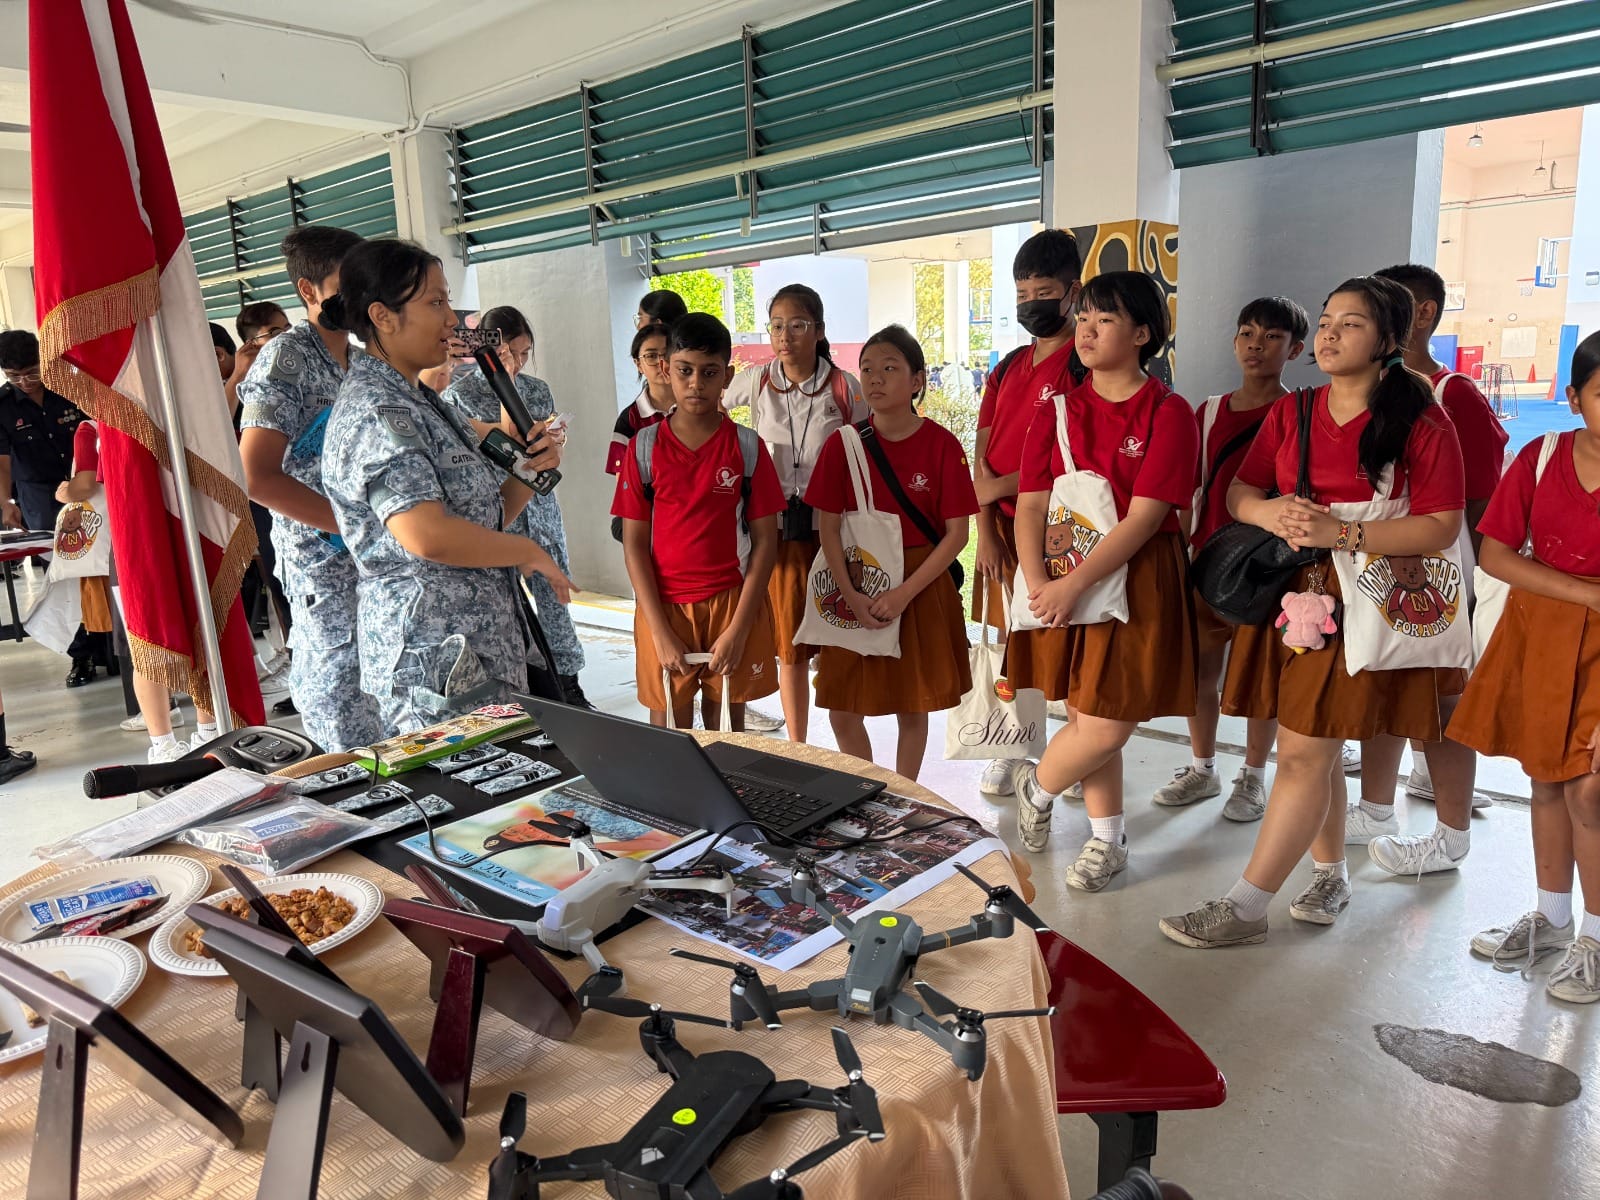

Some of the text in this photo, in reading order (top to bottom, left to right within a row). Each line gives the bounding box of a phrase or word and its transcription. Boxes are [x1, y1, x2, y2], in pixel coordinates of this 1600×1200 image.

[1073, 523, 1105, 558] STA
[812, 567, 838, 599] NOR
[1357, 556, 1461, 608] NORTH STAR
[1392, 614, 1450, 637] FOR A DAY
[958, 708, 1037, 747] Shine
[480, 860, 512, 878] NCC
